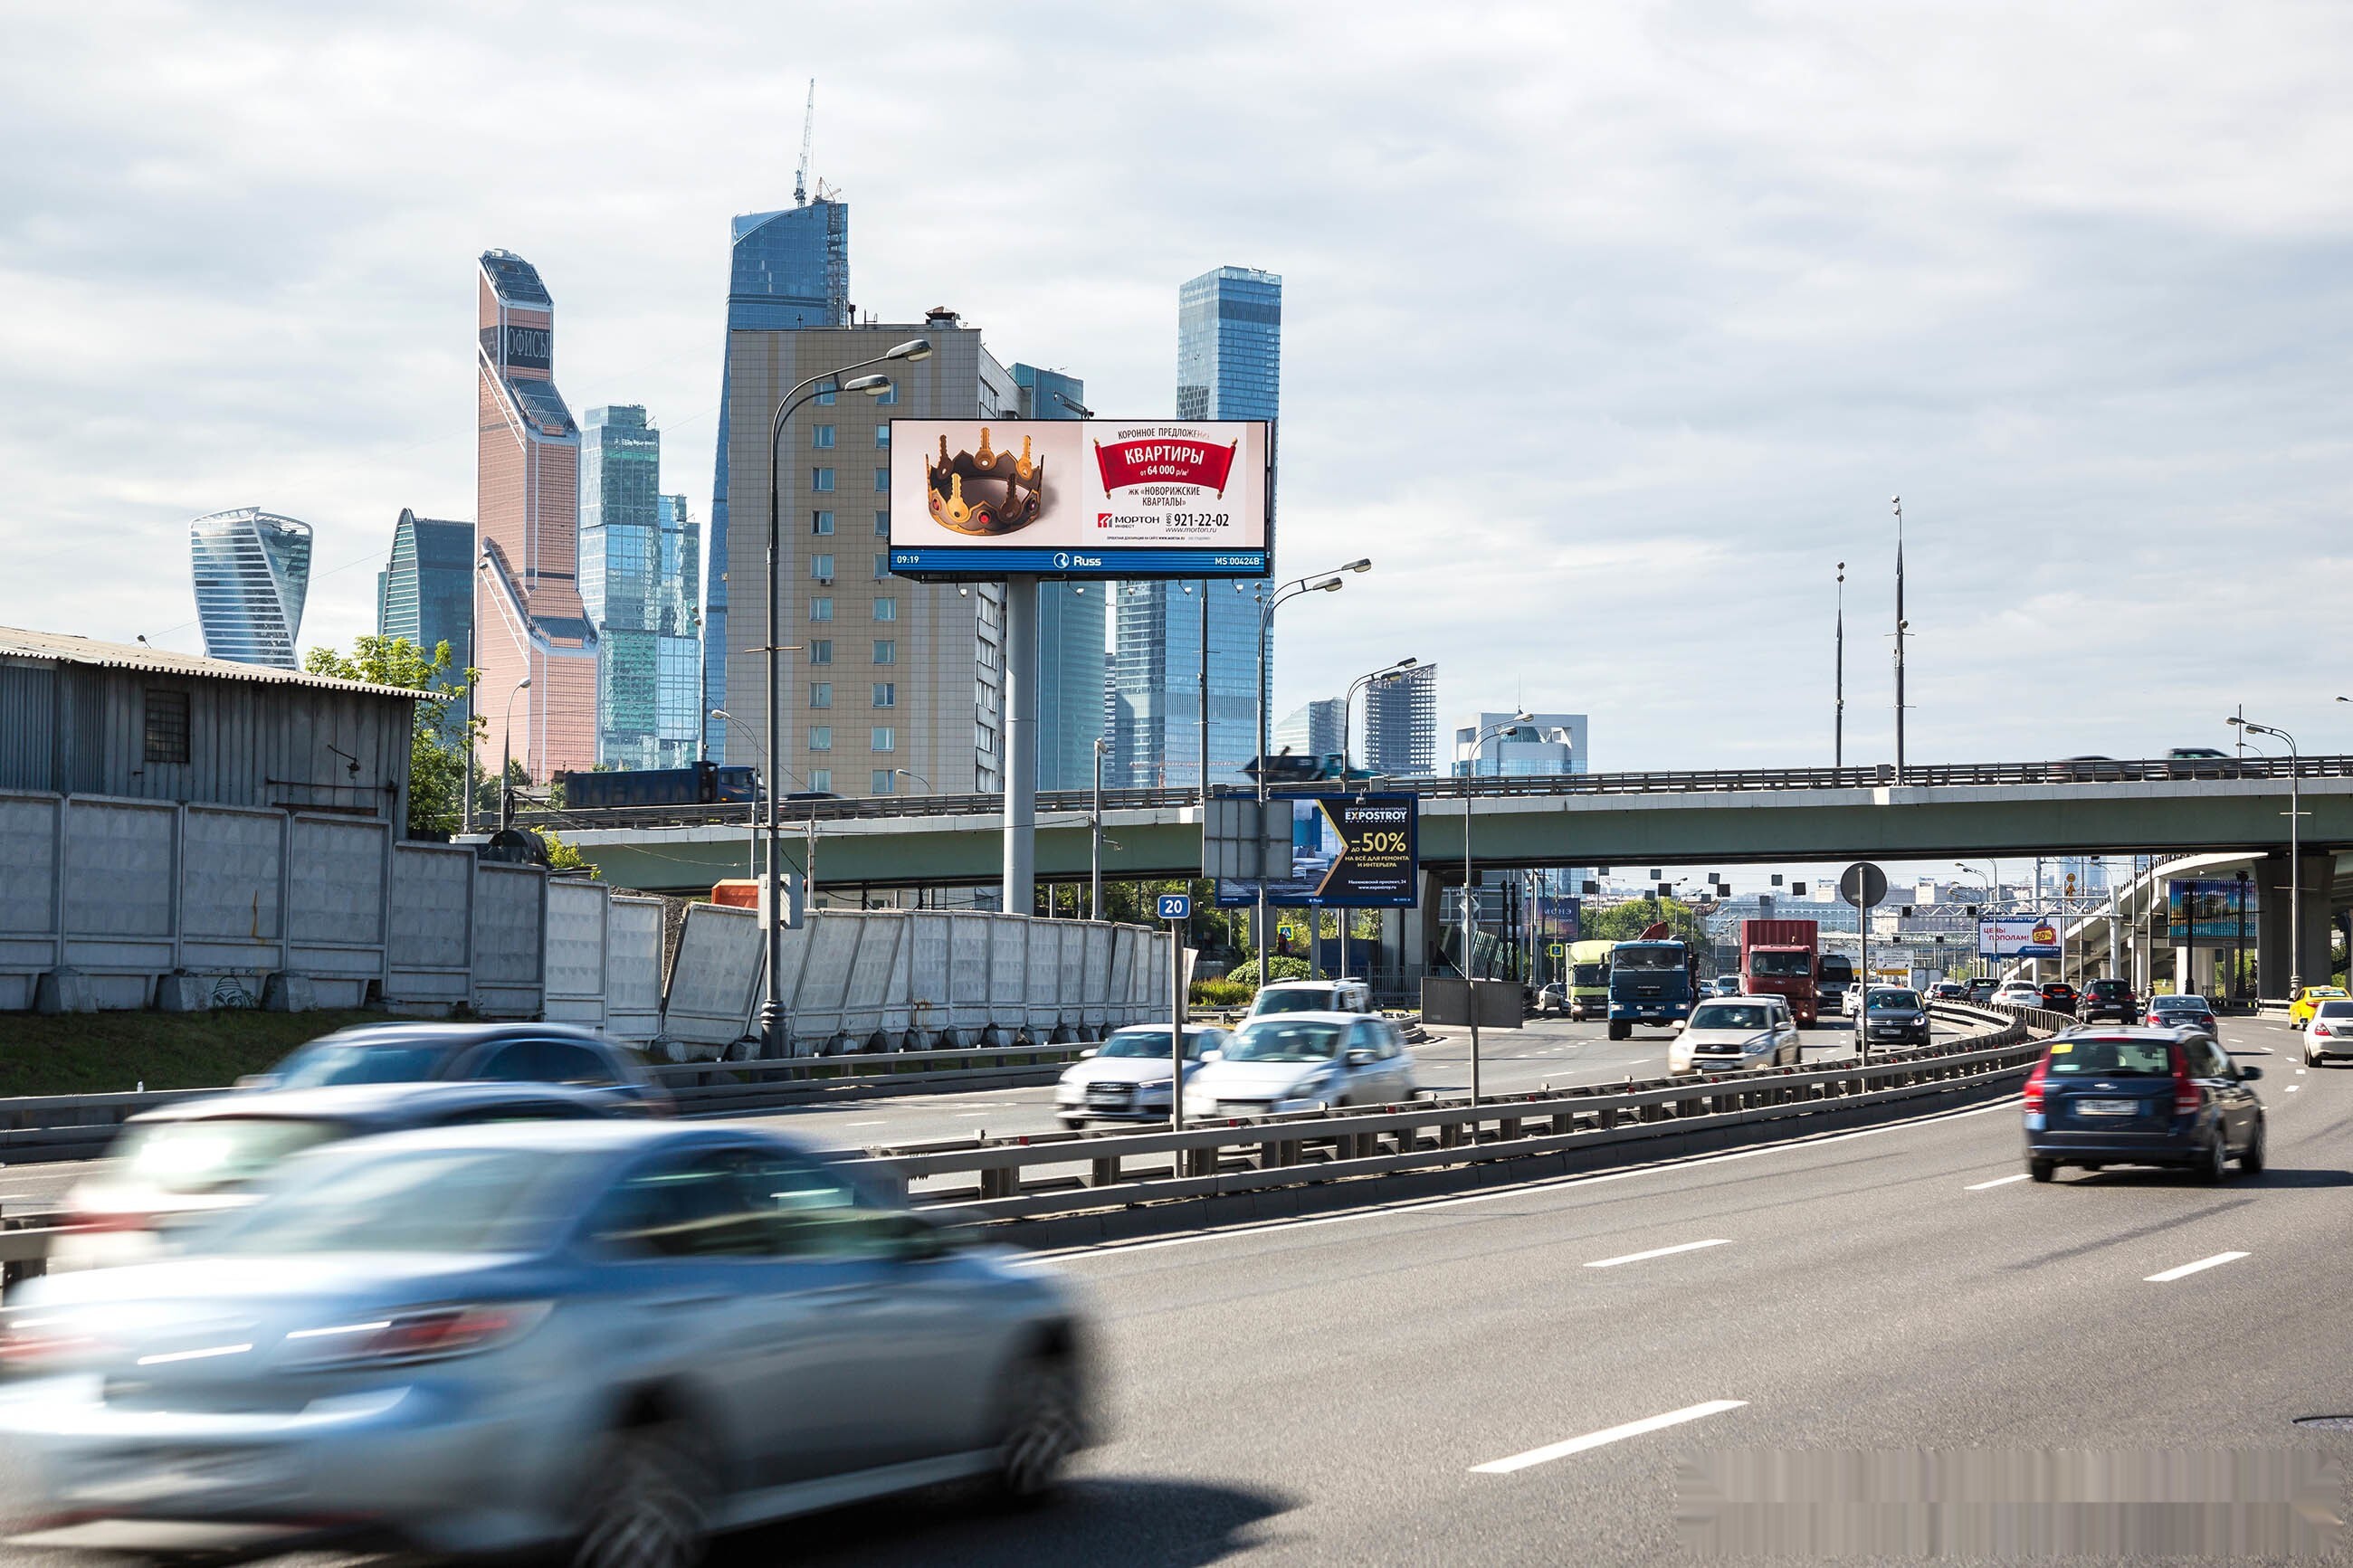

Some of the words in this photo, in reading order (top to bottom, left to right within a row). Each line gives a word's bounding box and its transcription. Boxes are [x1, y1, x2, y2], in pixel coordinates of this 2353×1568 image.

[508, 328, 550, 359] ОФИСЫ
[1118, 428, 1156, 440] КОРОННОЕ
[1125, 445, 1205, 465] КВАРТИРЫ
[1148, 465, 1157, 475] 64
[1159, 465, 1175, 475] 000
[1140, 486, 1201, 496] «НОВОРИЖСКИЕ
[1142, 497, 1186, 507] КВАРТАЛЫ»
[1115, 516, 1160, 524] МОРТОН
[1174, 513, 1229, 527] 921-22-02
[897, 556, 919, 564] 09:19
[1073, 556, 1101, 566] Russ
[1215, 557, 1228, 565] MS
[1345, 812, 1407, 820] EXPOSTROY
[1165, 899, 1183, 914] 20
